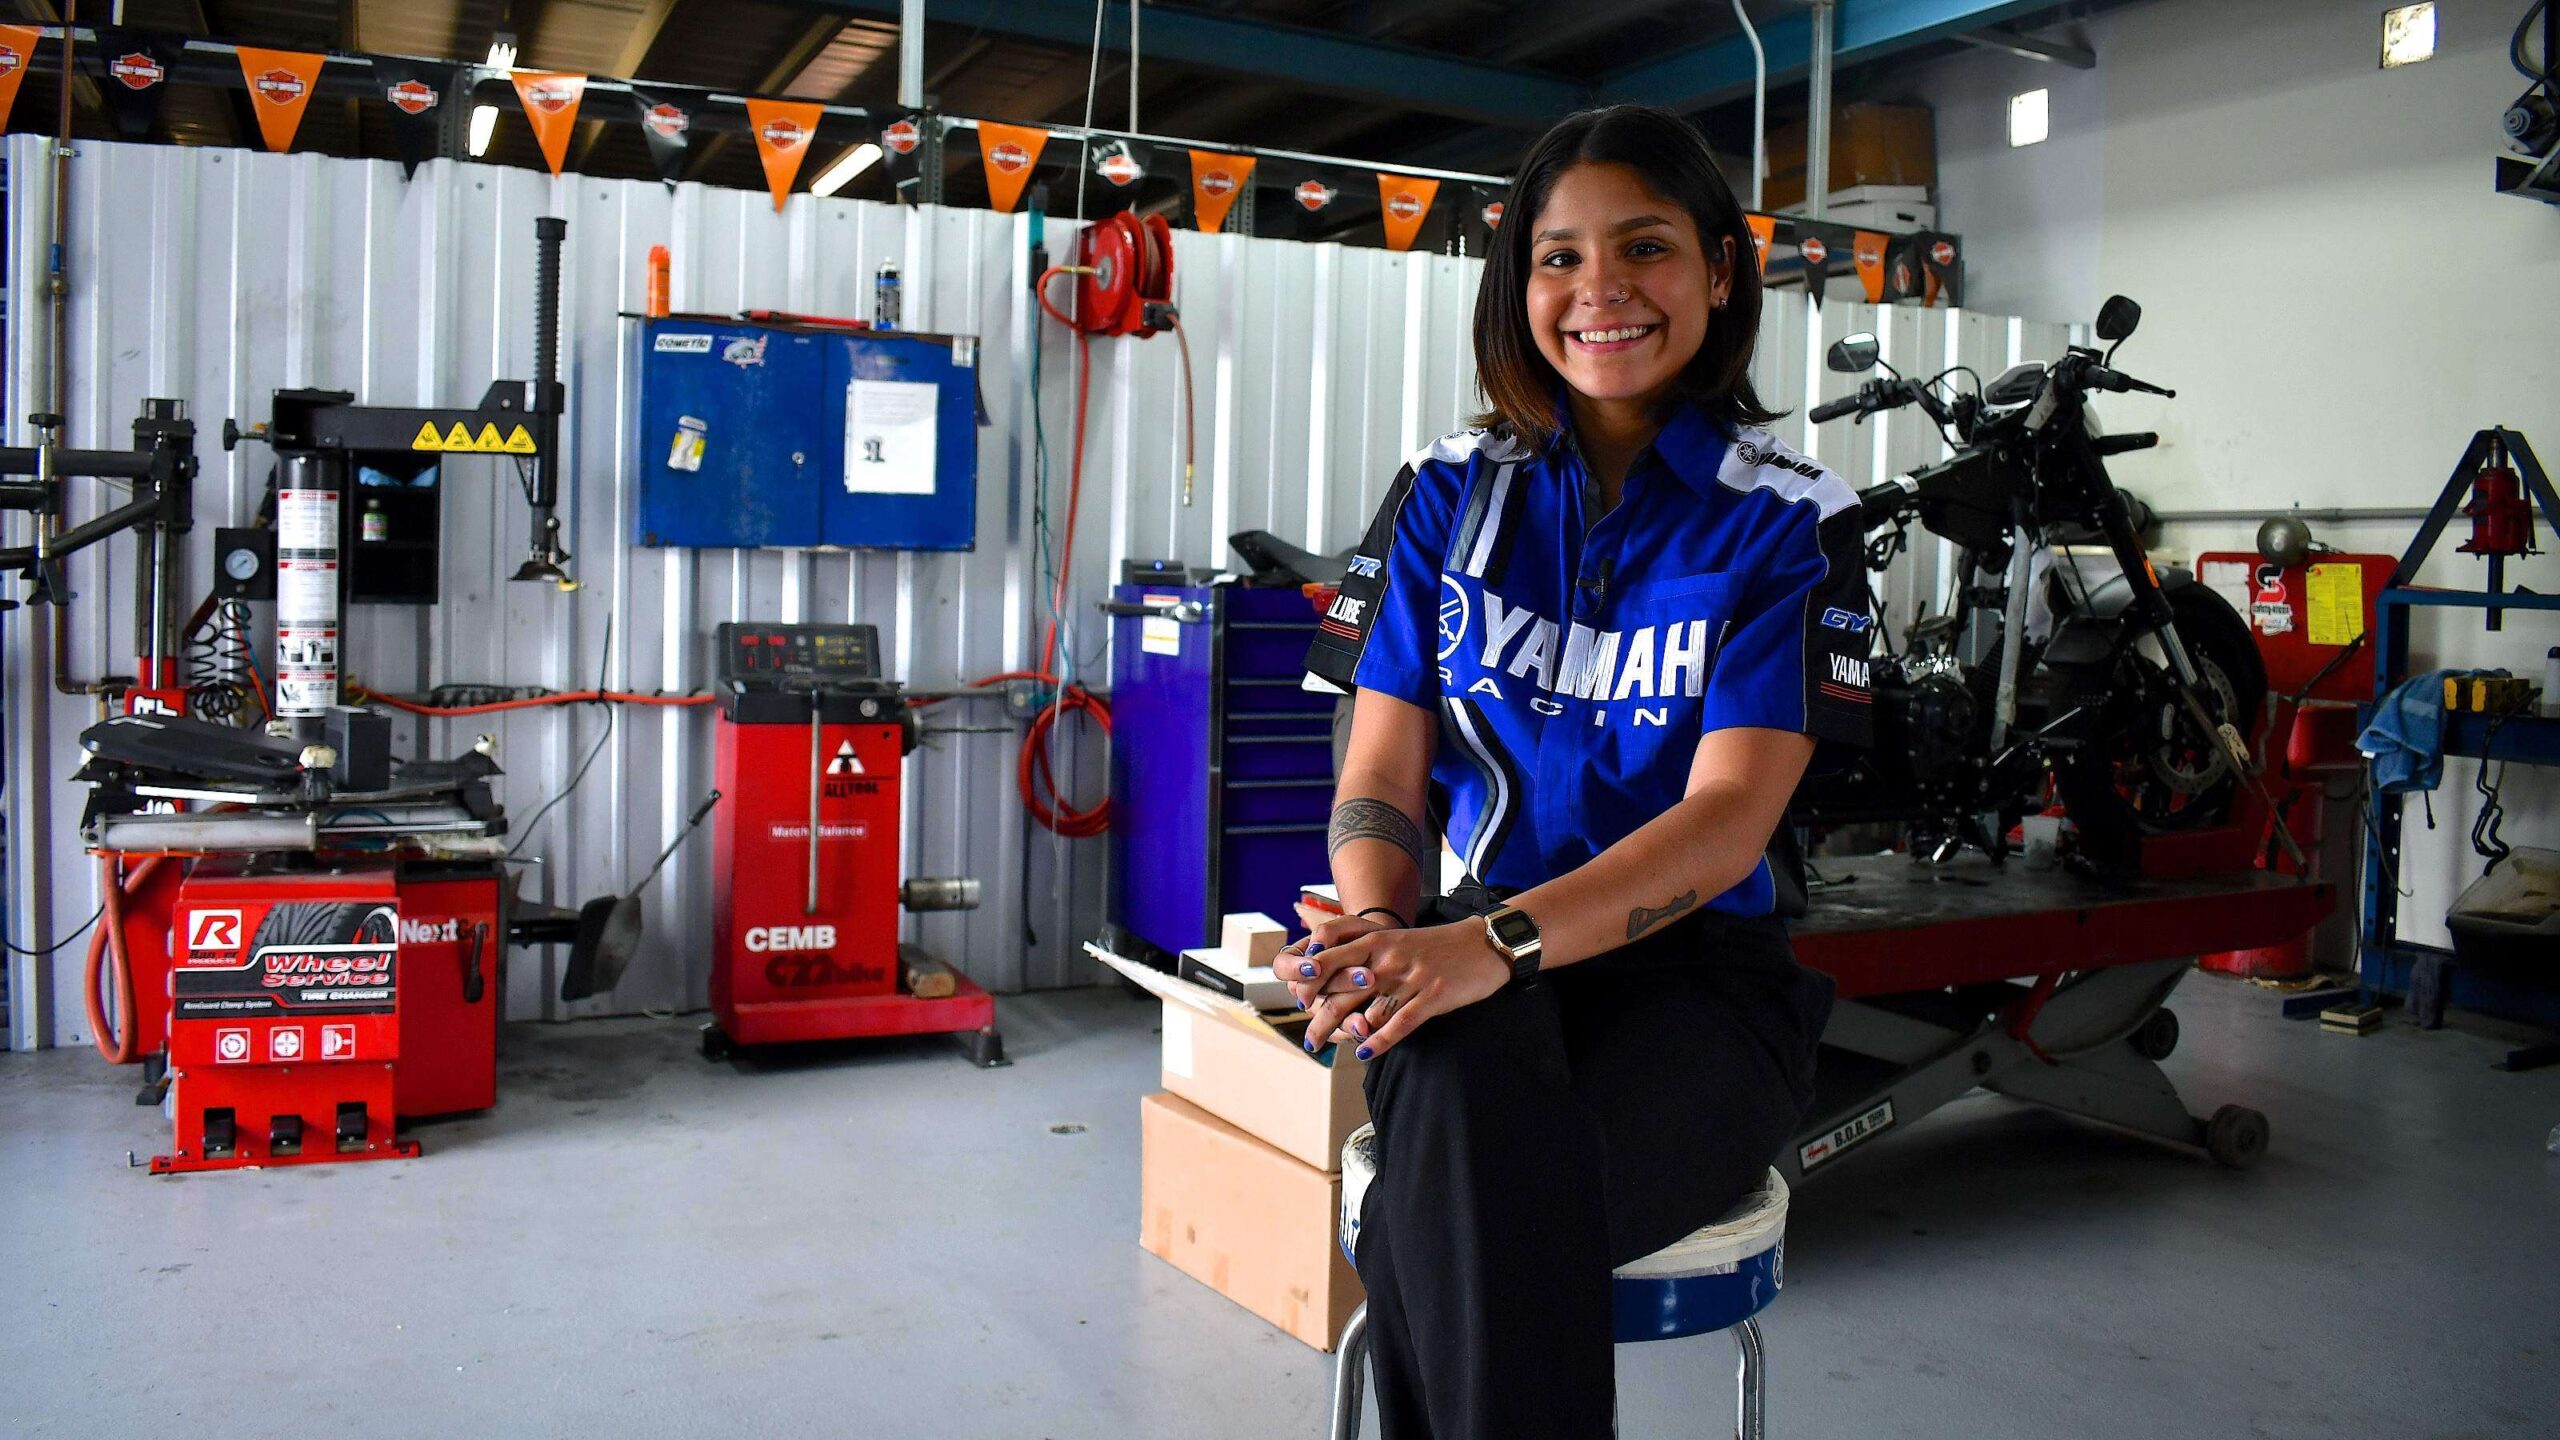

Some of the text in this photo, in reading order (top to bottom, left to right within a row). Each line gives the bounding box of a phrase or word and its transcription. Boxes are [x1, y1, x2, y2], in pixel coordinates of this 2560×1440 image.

[1483, 589, 1731, 700] YAMAH
[1830, 652, 1871, 688] YAMA
[1439, 666, 1702, 727] RACIN
[745, 925, 837, 952] CEMB
[264, 951, 391, 973] Wheel
[261, 971, 390, 987] Service
[329, 991, 388, 1001] CHANGER
[1834, 1120, 1868, 1149] B.O.B.
